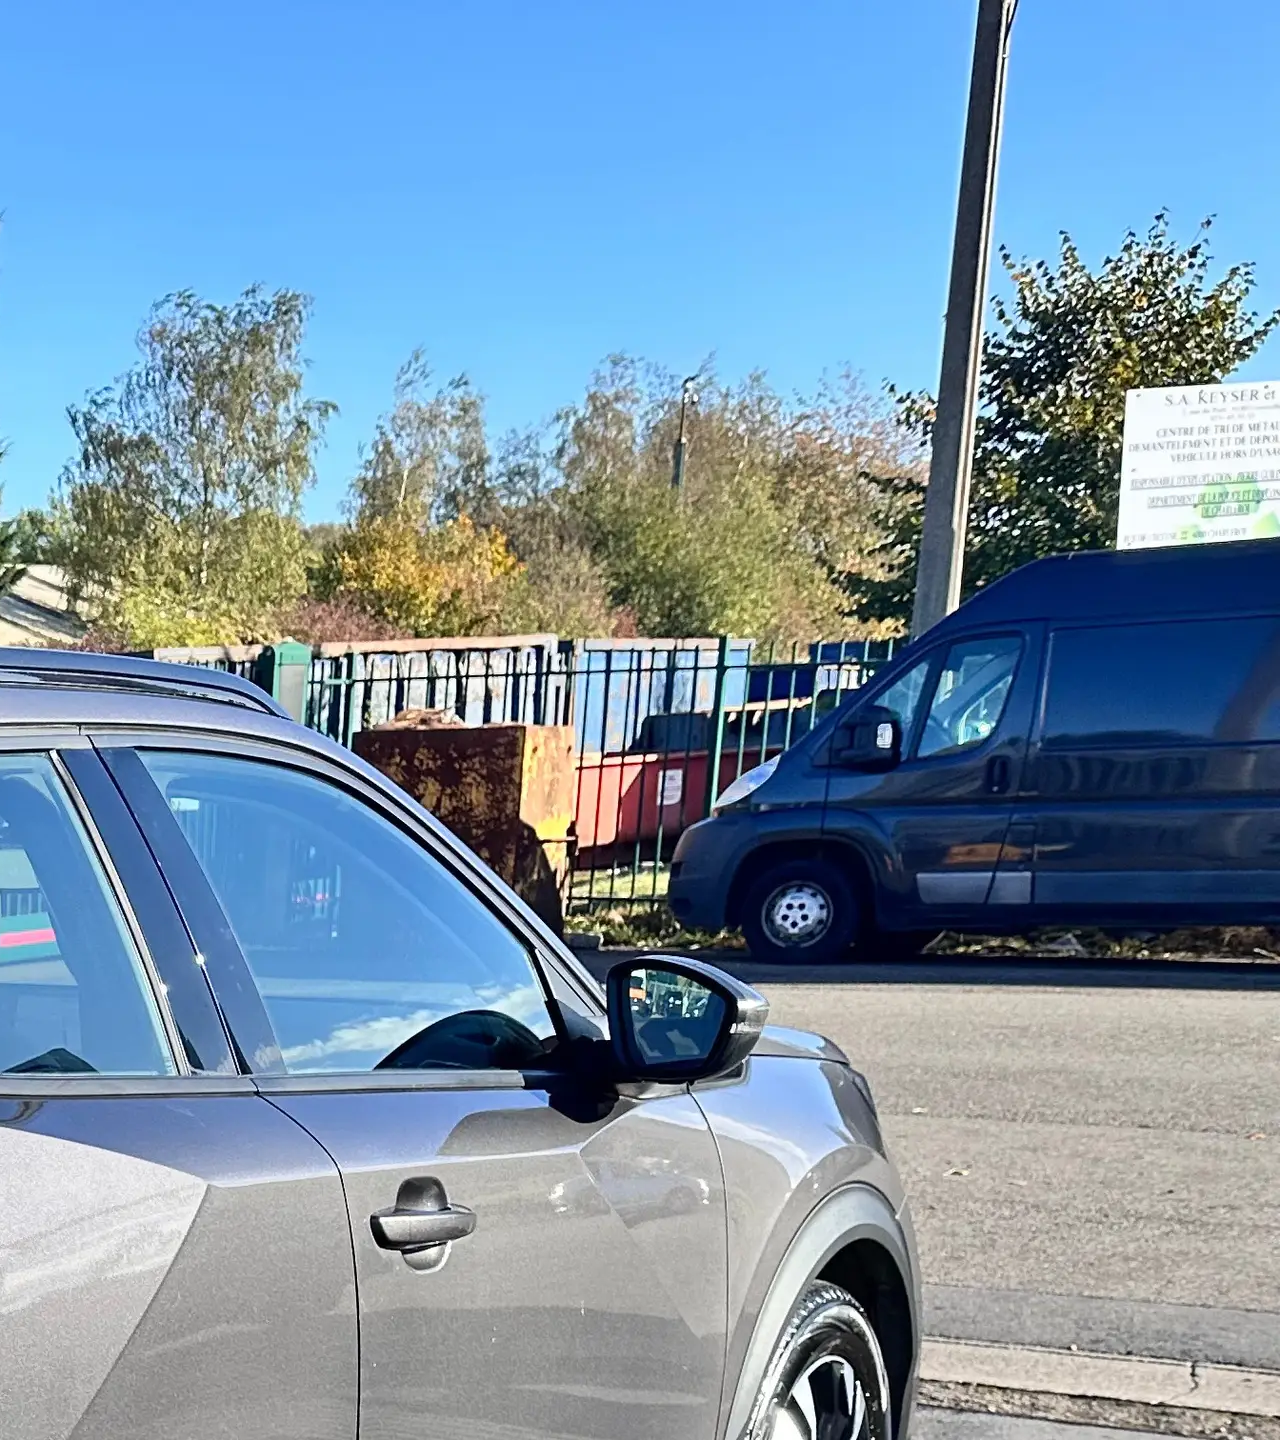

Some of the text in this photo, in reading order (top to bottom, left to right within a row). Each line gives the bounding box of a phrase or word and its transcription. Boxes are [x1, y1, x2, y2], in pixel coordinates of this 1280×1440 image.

[1198, 389, 1260, 405] KEYSER
[1156, 426, 1195, 438] CENTRE
[1197, 426, 1211, 436] DE
